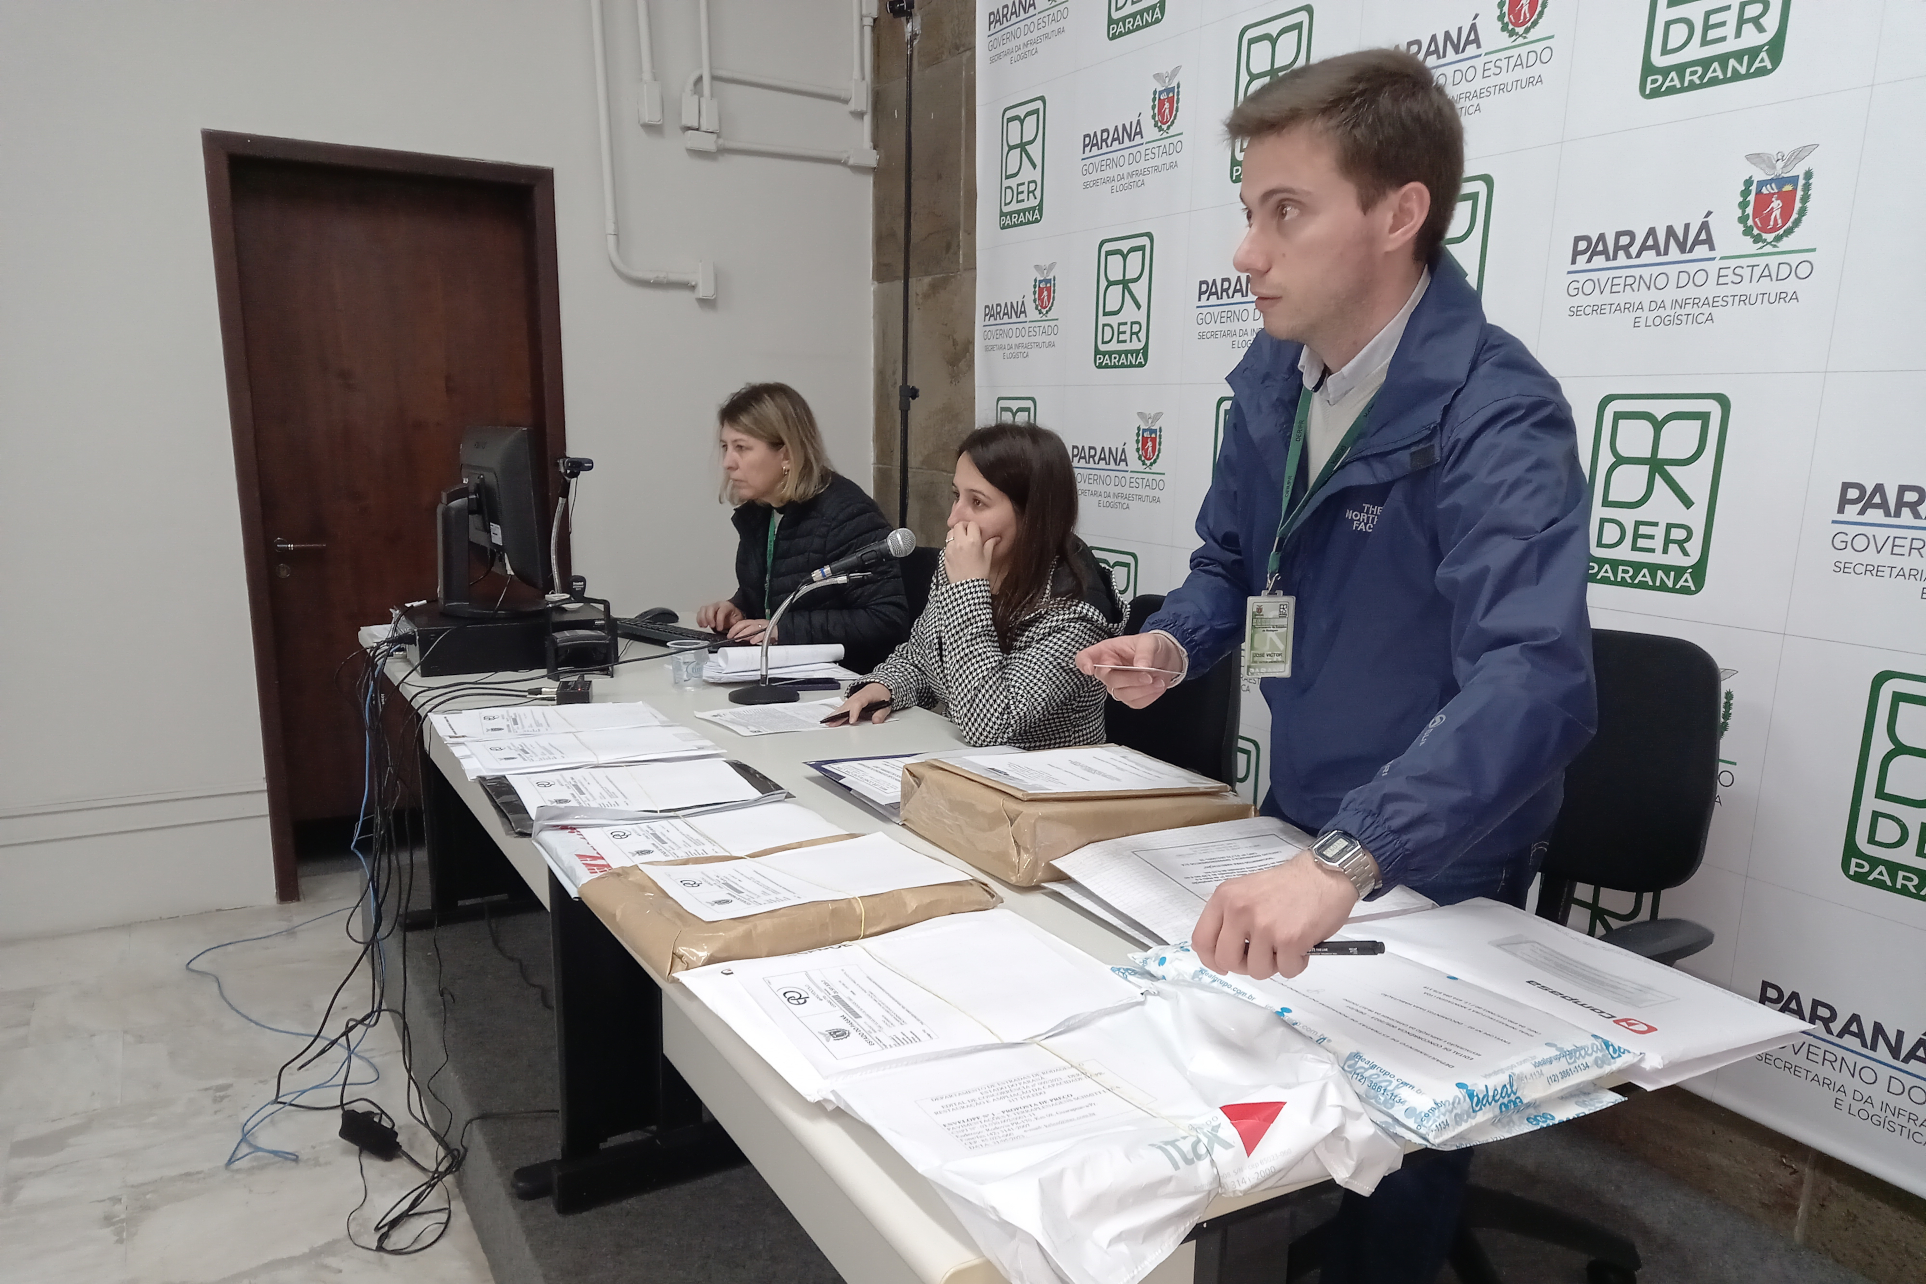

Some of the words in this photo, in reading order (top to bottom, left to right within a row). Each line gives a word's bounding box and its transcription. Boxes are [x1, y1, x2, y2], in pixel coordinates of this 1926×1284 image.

[987, 27, 1021, 52] GOVERNO
[1023, 22, 1036, 36] DO
[1036, 6, 1069, 31] ESTADO
[1109, 4, 1162, 38] PARANÁ
[1659, 0, 1768, 57] DER
[1452, 65, 1477, 87] DO
[1482, 46, 1553, 79] ESTADO
[1645, 46, 1773, 95] PARANÁ
[1082, 112, 1143, 154] PARANÁ
[1081, 155, 1125, 176] GOVERNO
[1128, 151, 1141, 165] DO
[1144, 140, 1182, 161] ESTADO
[1083, 176, 1115, 189] SECRETARIA
[1117, 173, 1124, 182] DA
[1126, 161, 1178, 179] INFRAESTRUTURA
[1111, 185, 1114, 193] E
[1116, 179, 1145, 192] LOGÍSTICA
[1004, 180, 1037, 206] DER
[1000, 206, 1040, 227] PARANÁ
[1571, 210, 1716, 265] PARANÁ
[1198, 275, 1251, 302] PARA
[1567, 272, 1669, 298] GOVERNO
[1675, 269, 1709, 288] DO
[1716, 260, 1814, 286] ESTADO
[984, 295, 1027, 322] PARANÁ
[1196, 308, 1249, 326] GOVERNO
[1253, 308, 1261, 321] D
[1568, 300, 1645, 317] SECRETARIA
[1648, 299, 1667, 312] DA
[1670, 291, 1800, 310] INFRAESTRUTURA
[983, 328, 1013, 340] GOVERNO
[1015, 327, 1026, 338] DO
[1028, 324, 1059, 337] ESTADO
[1101, 321, 1142, 344] DER
[1633, 316, 1642, 328] E
[1644, 311, 1714, 328] LOGÍSTICA
[1198, 329, 1237, 340] SECRETARIA
[1239, 328, 1248, 337] DA
[1232, 340, 1236, 349] E
[1096, 350, 1145, 366] PARANÁ
[1071, 442, 1128, 467] PARANÁ
[1076, 473, 1111, 486] OVERNO
[1114, 475, 1126, 487] DO
[1129, 477, 1165, 491] ESTADO
[1078, 489, 1102, 498] CRETARIA
[1113, 492, 1161, 504] INFRAESTRUTURA
[1837, 481, 1926, 520] PAR
[1353, 521, 1374, 533] FAC
[1596, 517, 1694, 557] DER
[1831, 531, 1926, 558] GOVER
[1588, 562, 1696, 591] PARANÁ
[1833, 560, 1926, 582] SECRETARI
[1849, 857, 1926, 895] PAR
[1546, 1072, 1559, 1086] (12)
[1559, 1062, 1590, 1079] 3861-1134
[1755, 1052, 1847, 1097] SECRETARIA
[1853, 1089, 1875, 1109] DA
[1790, 1040, 1878, 1085] VERNO
[1887, 1075, 1926, 1106] DO
[1351, 1071, 1367, 1086] (12)
[1367, 1081, 1407, 1106] 3861-1134
[1834, 1097, 1844, 1111] E
